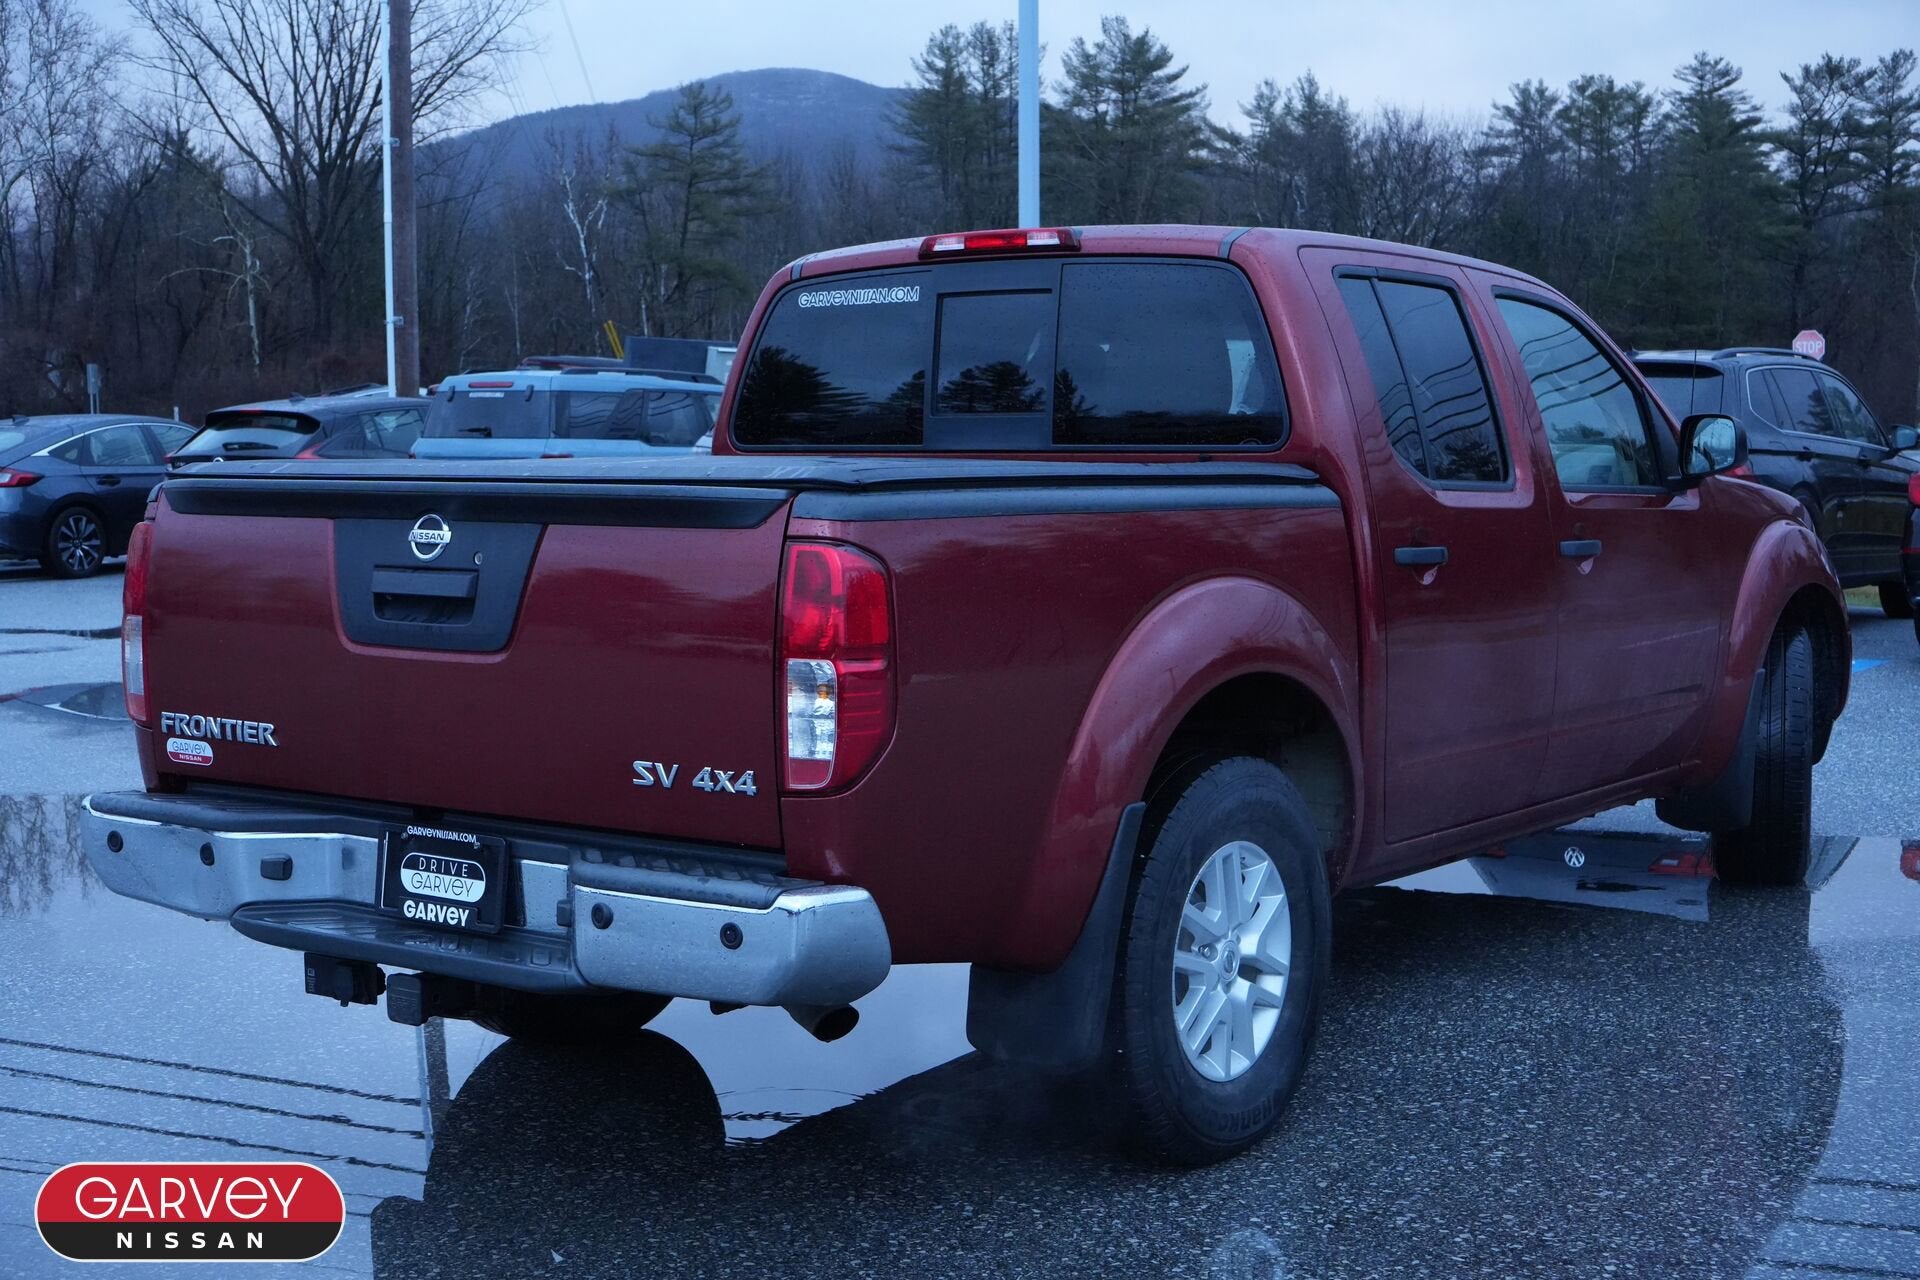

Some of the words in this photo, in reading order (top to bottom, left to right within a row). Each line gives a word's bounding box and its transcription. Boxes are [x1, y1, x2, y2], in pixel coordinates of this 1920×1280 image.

[1795, 340, 1823, 353] STOP
[410, 531, 445, 541] NISSAN
[160, 711, 279, 747] FRONTIER
[179, 754, 202, 762] NISSAN
[632, 760, 680, 788] SV
[418, 857, 469, 877] DRIVE
